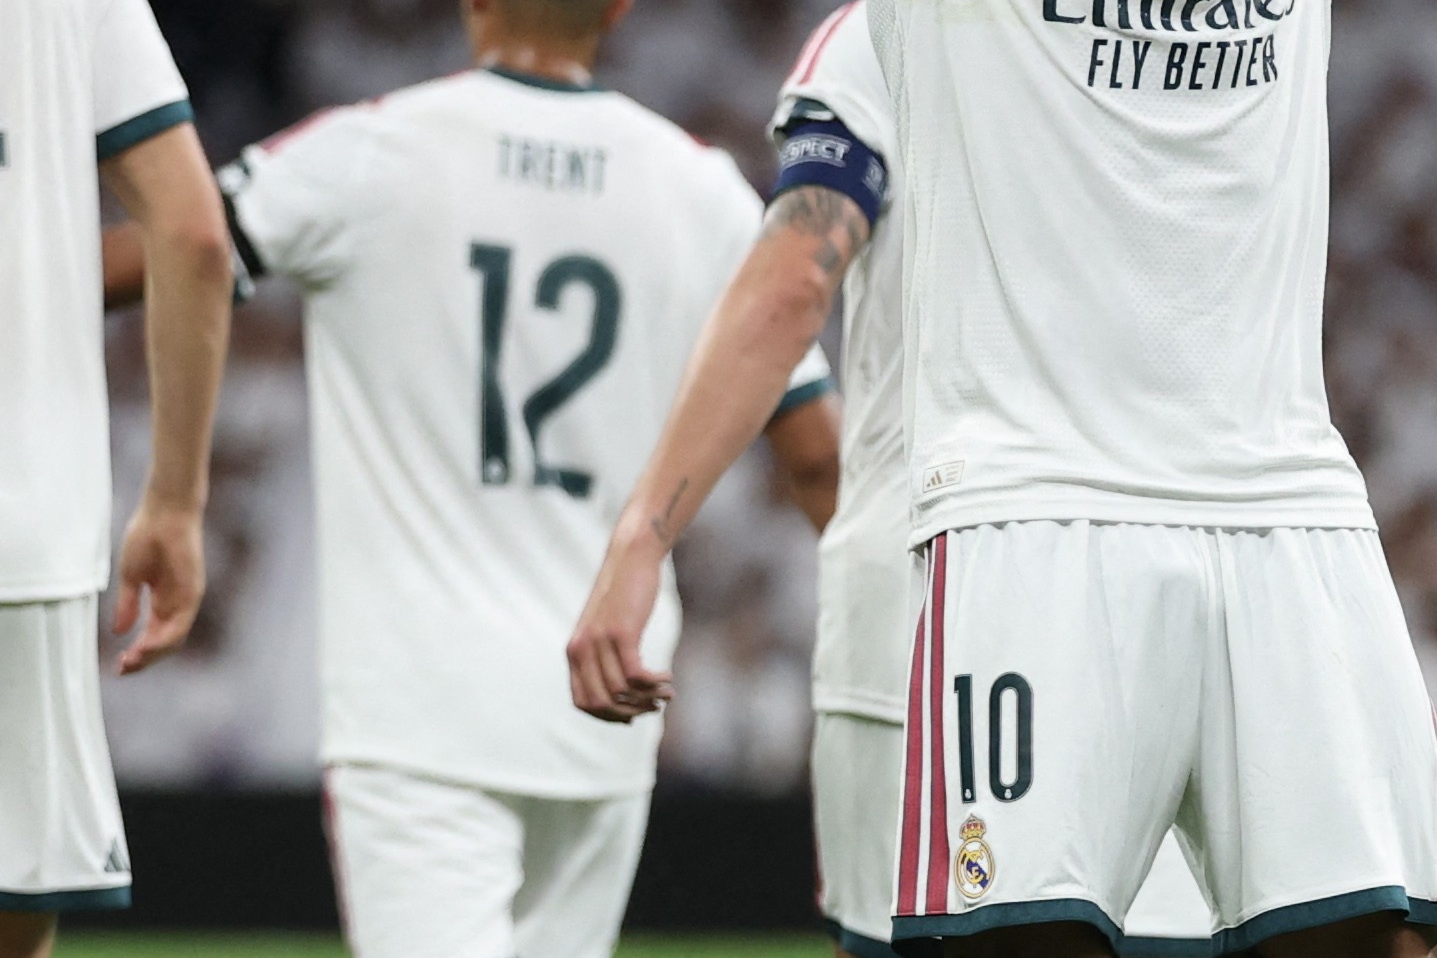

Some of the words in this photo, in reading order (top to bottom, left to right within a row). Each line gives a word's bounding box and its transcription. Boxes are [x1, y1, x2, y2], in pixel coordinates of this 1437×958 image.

[1087, 38, 1151, 90] FLY
[1162, 33, 1279, 90] BETTER
[469, 240, 622, 499] 12
[953, 672, 1034, 804] 10
